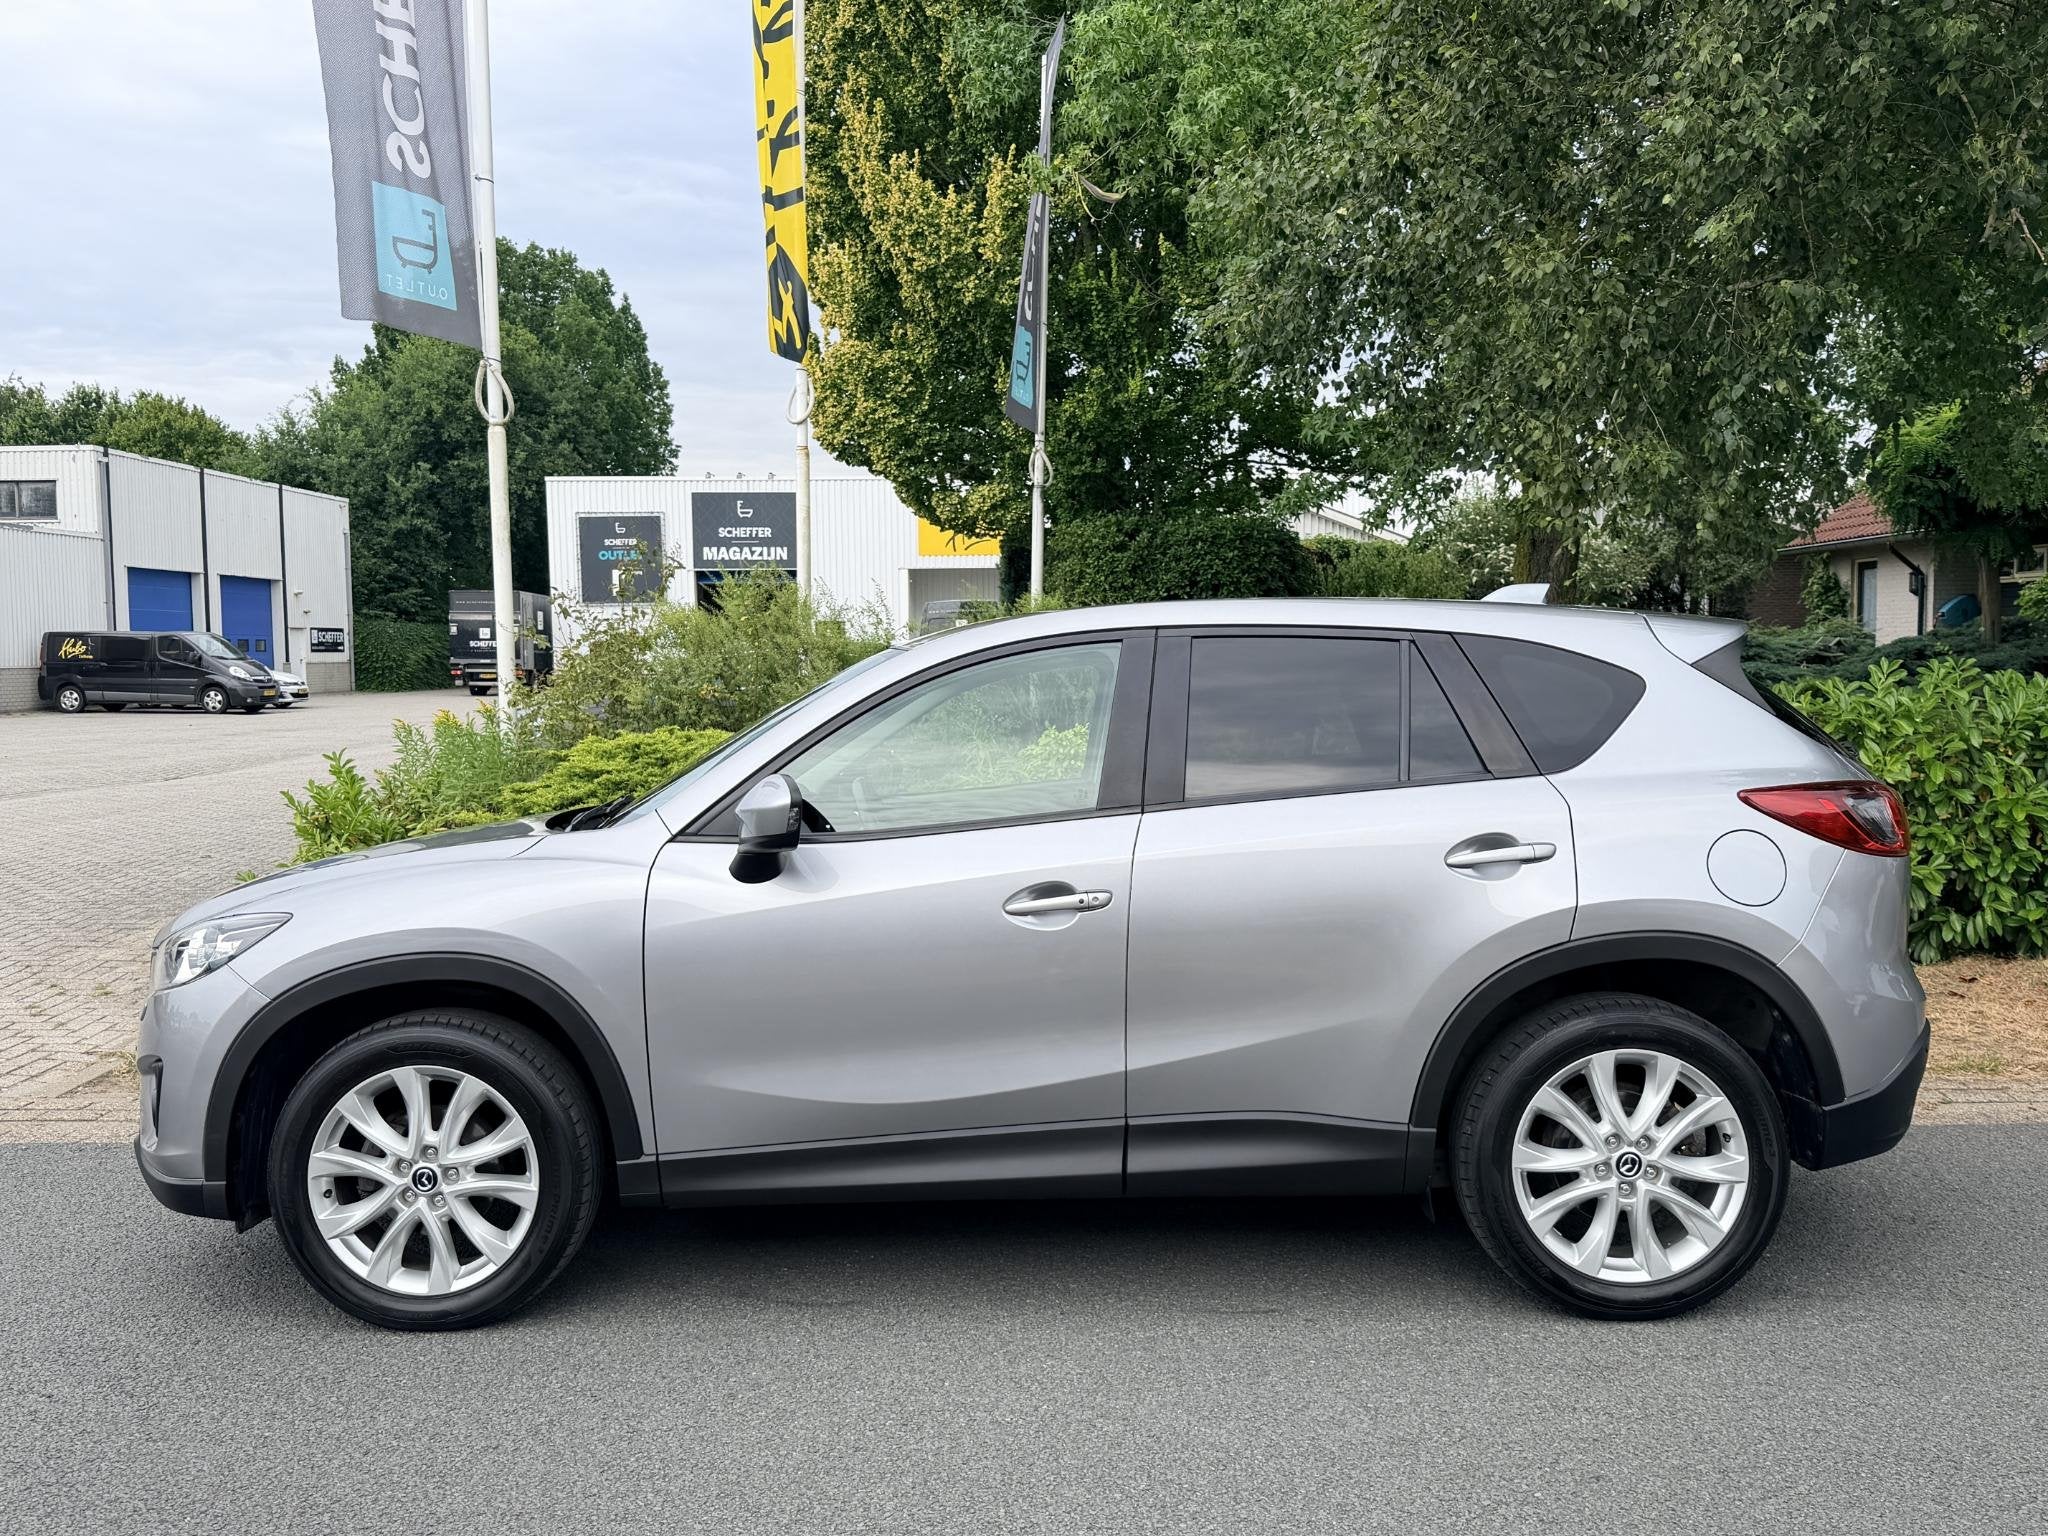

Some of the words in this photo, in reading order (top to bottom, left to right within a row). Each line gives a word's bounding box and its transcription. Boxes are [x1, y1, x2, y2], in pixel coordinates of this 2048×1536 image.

[718, 526, 772, 538] SCHEFFER
[702, 546, 788, 561] MAGAZIJN
[318, 631, 344, 643] SCHEFFER
